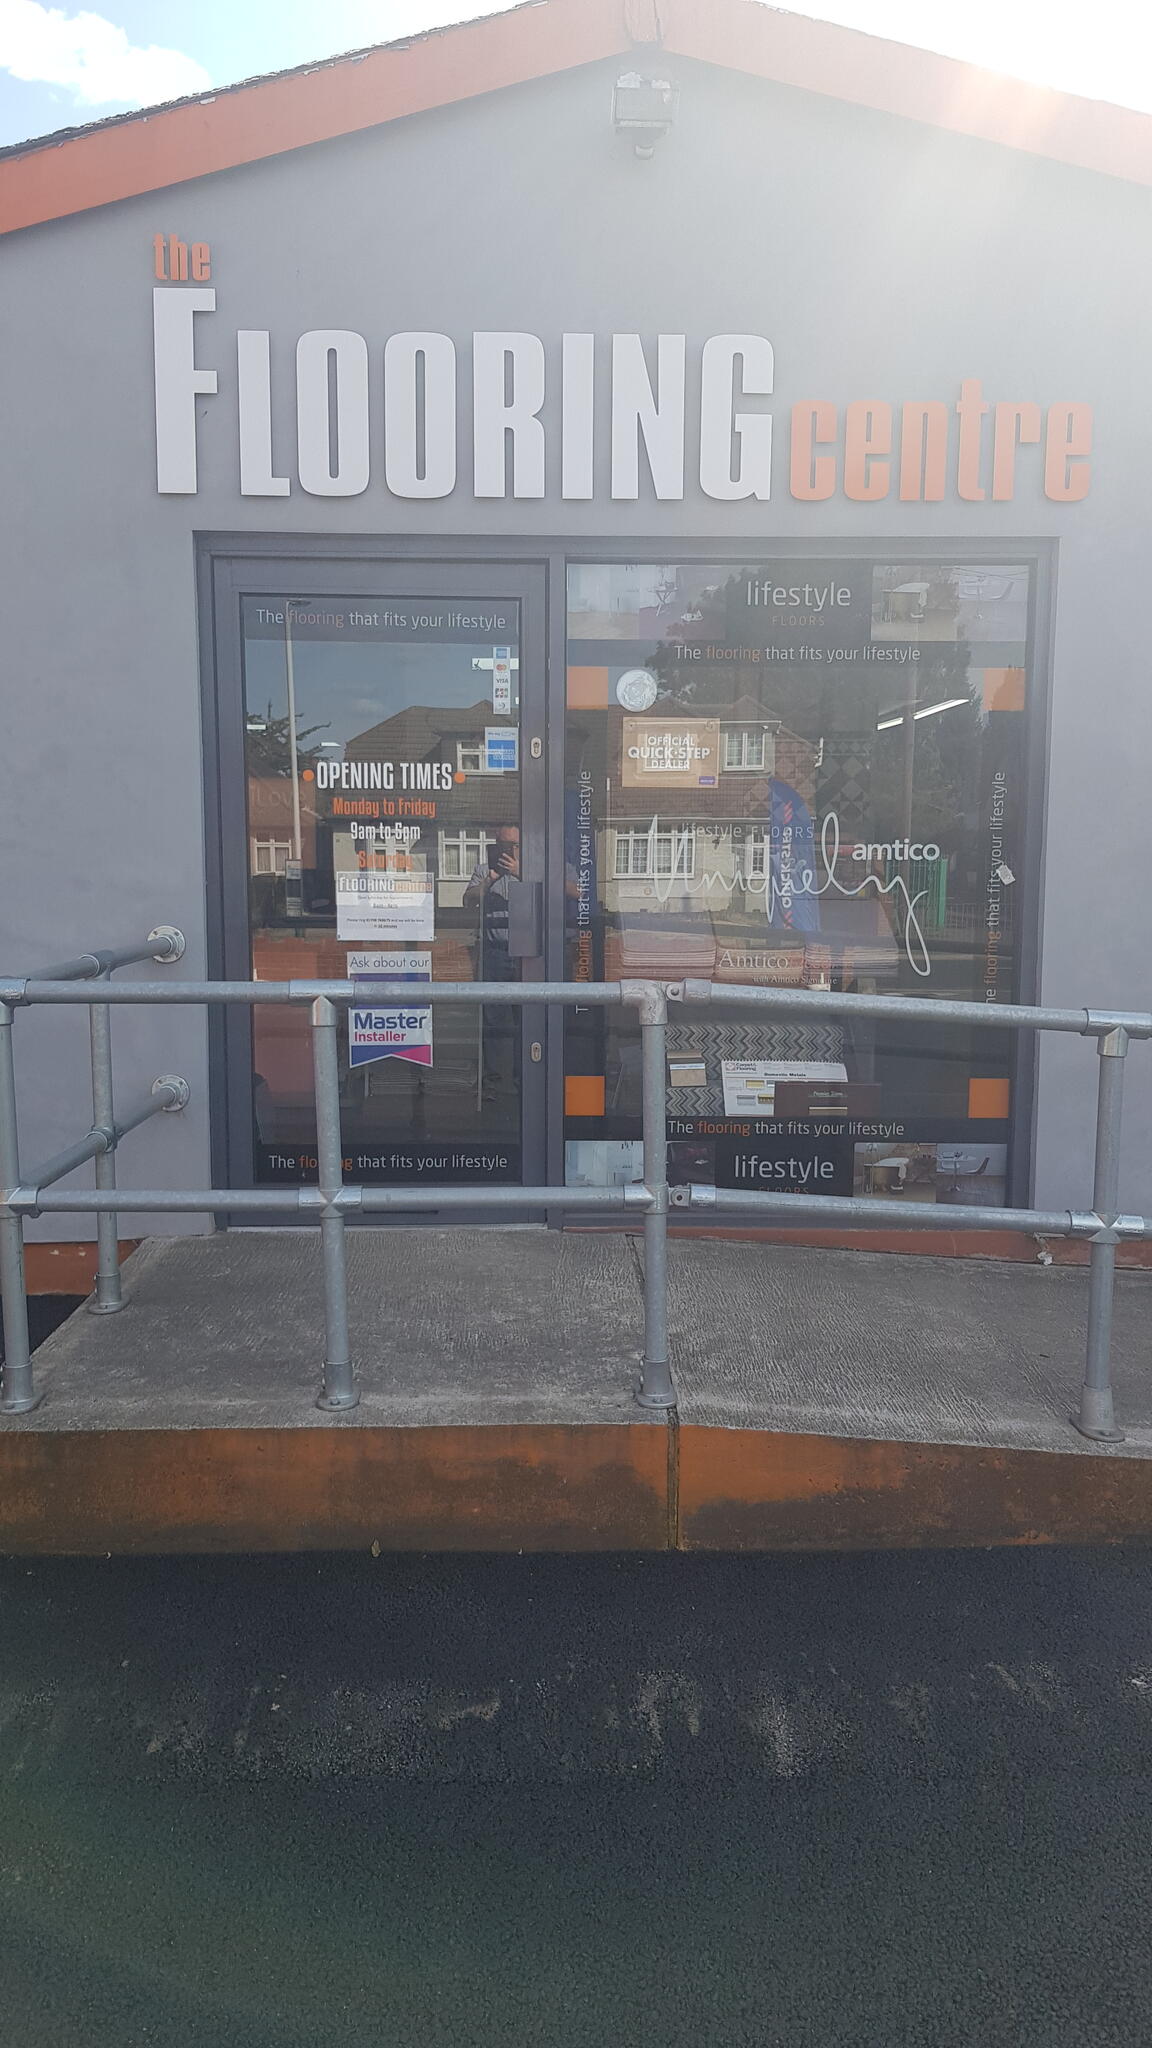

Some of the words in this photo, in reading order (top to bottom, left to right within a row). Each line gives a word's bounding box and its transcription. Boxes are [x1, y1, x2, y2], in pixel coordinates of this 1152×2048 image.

[153, 233, 211, 282] the
[153, 286, 775, 501] FLOORING
[790, 378, 1094, 502] centre
[746, 581, 851, 612] lifestyle
[257, 608, 285, 625] The
[287, 609, 345, 629] flooring
[349, 611, 379, 627] that
[383, 611, 407, 628] fits
[411, 614, 443, 631] your
[448, 612, 507, 631] lifestyle
[772, 615, 826, 627] FLOORS
[674, 645, 702, 660] The
[706, 645, 761, 663] flooring
[765, 647, 795, 661] that
[799, 646, 823, 661] fits
[827, 649, 859, 664] your
[863, 646, 921, 664] lifestyle
[647, 735, 696, 746] OFFICIAL
[316, 761, 395, 791] OPENING
[400, 761, 453, 791] TIMES
[651, 759, 690, 770] DEALER
[333, 797, 380, 818] Monday
[383, 799, 395, 816] to
[398, 797, 437, 818] Friday
[577, 770, 594, 831] lifestyle
[990, 771, 1008, 831] lifestyle
[350, 821, 376, 840] 9am
[379, 822, 391, 840] to
[681, 822, 743, 841] lifestyle
[752, 825, 815, 839] FLOORS
[357, 850, 414, 872] Saturday
[580, 833, 593, 866] your
[852, 838, 941, 862] amtico
[990, 833, 1005, 866] your
[339, 876, 395, 892] FLOORING
[577, 869, 591, 894] fits
[987, 867, 1001, 894] fits
[577, 895, 591, 927] that
[986, 896, 1001, 927] that
[350, 957, 371, 969] Ask
[373, 956, 407, 969] about
[409, 959, 430, 969] our
[576, 930, 593, 983] flooring
[718, 949, 789, 970] Amtico
[984, 930, 1001, 985] flooring
[354, 1012, 428, 1031] Master
[354, 1031, 407, 1043] Installer
[668, 1120, 694, 1135] The
[698, 1121, 750, 1137] flooring
[755, 1121, 784, 1135] that
[787, 1121, 810, 1135] fits
[814, 1125, 845, 1138] your
[848, 1121, 904, 1138] lifestyle
[269, 1155, 296, 1169] The
[299, 1155, 353, 1171] flog
[357, 1156, 387, 1169] that
[391, 1155, 414, 1169] fits
[417, 1158, 448, 1172] your
[451, 1155, 508, 1171] lifestyle
[734, 1155, 835, 1184] lifestyle
